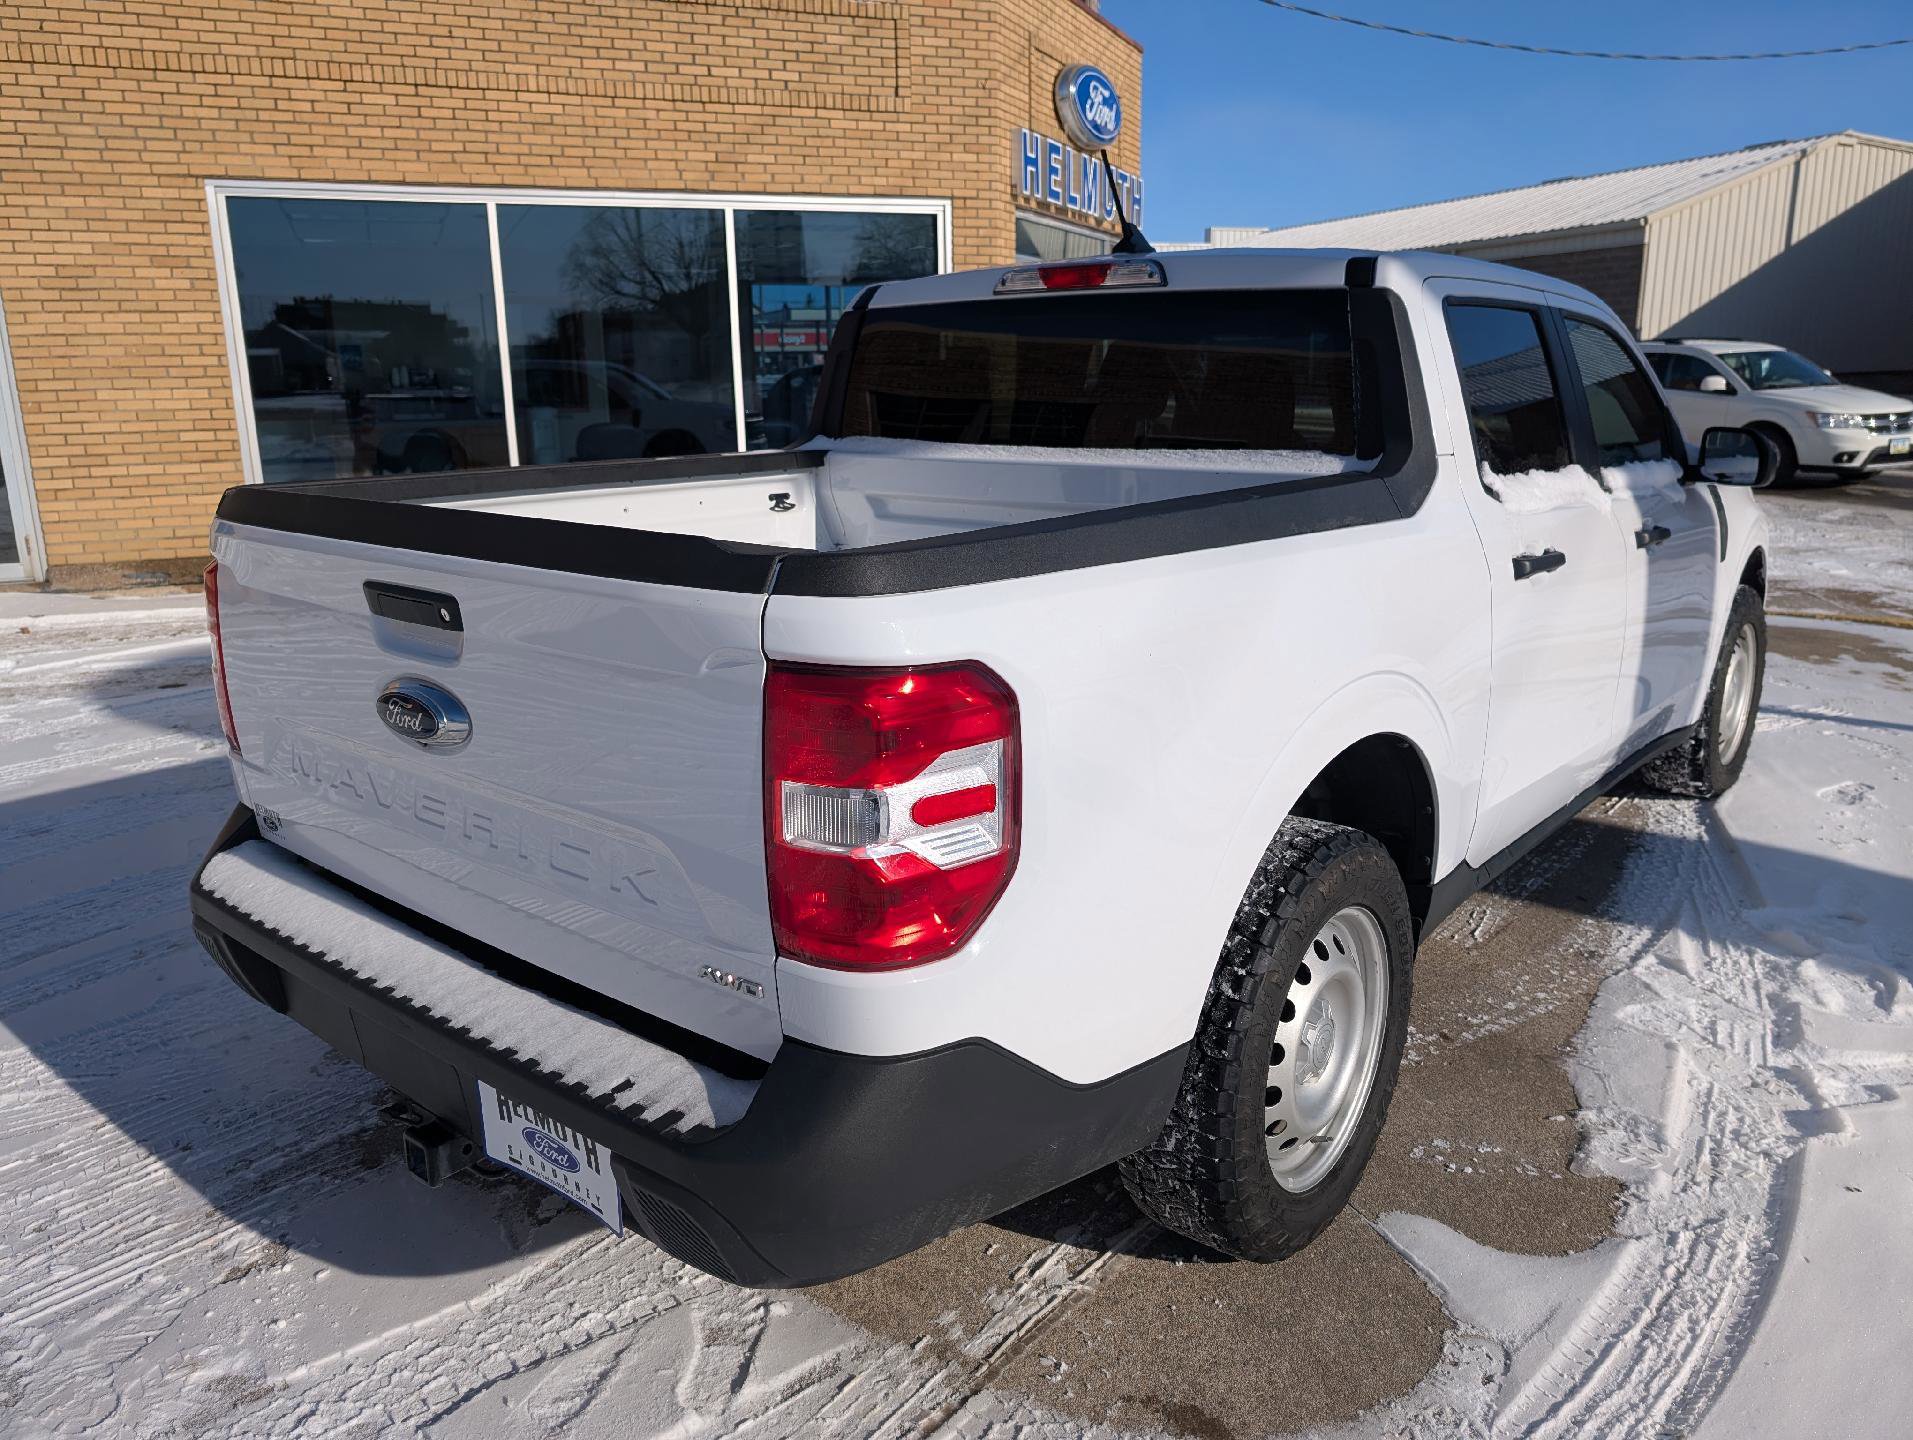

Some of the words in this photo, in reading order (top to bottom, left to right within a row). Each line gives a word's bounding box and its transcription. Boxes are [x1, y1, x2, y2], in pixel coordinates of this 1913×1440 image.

[1085, 79, 1117, 132] Ford
[1021, 127, 1145, 231] HELMUTH
[386, 697, 423, 731] Ford
[287, 738, 660, 907] MAVERICK
[697, 964, 765, 999] AWD
[507, 1143, 601, 1206] SIGOURNEY
[533, 1132, 570, 1168] Ford
